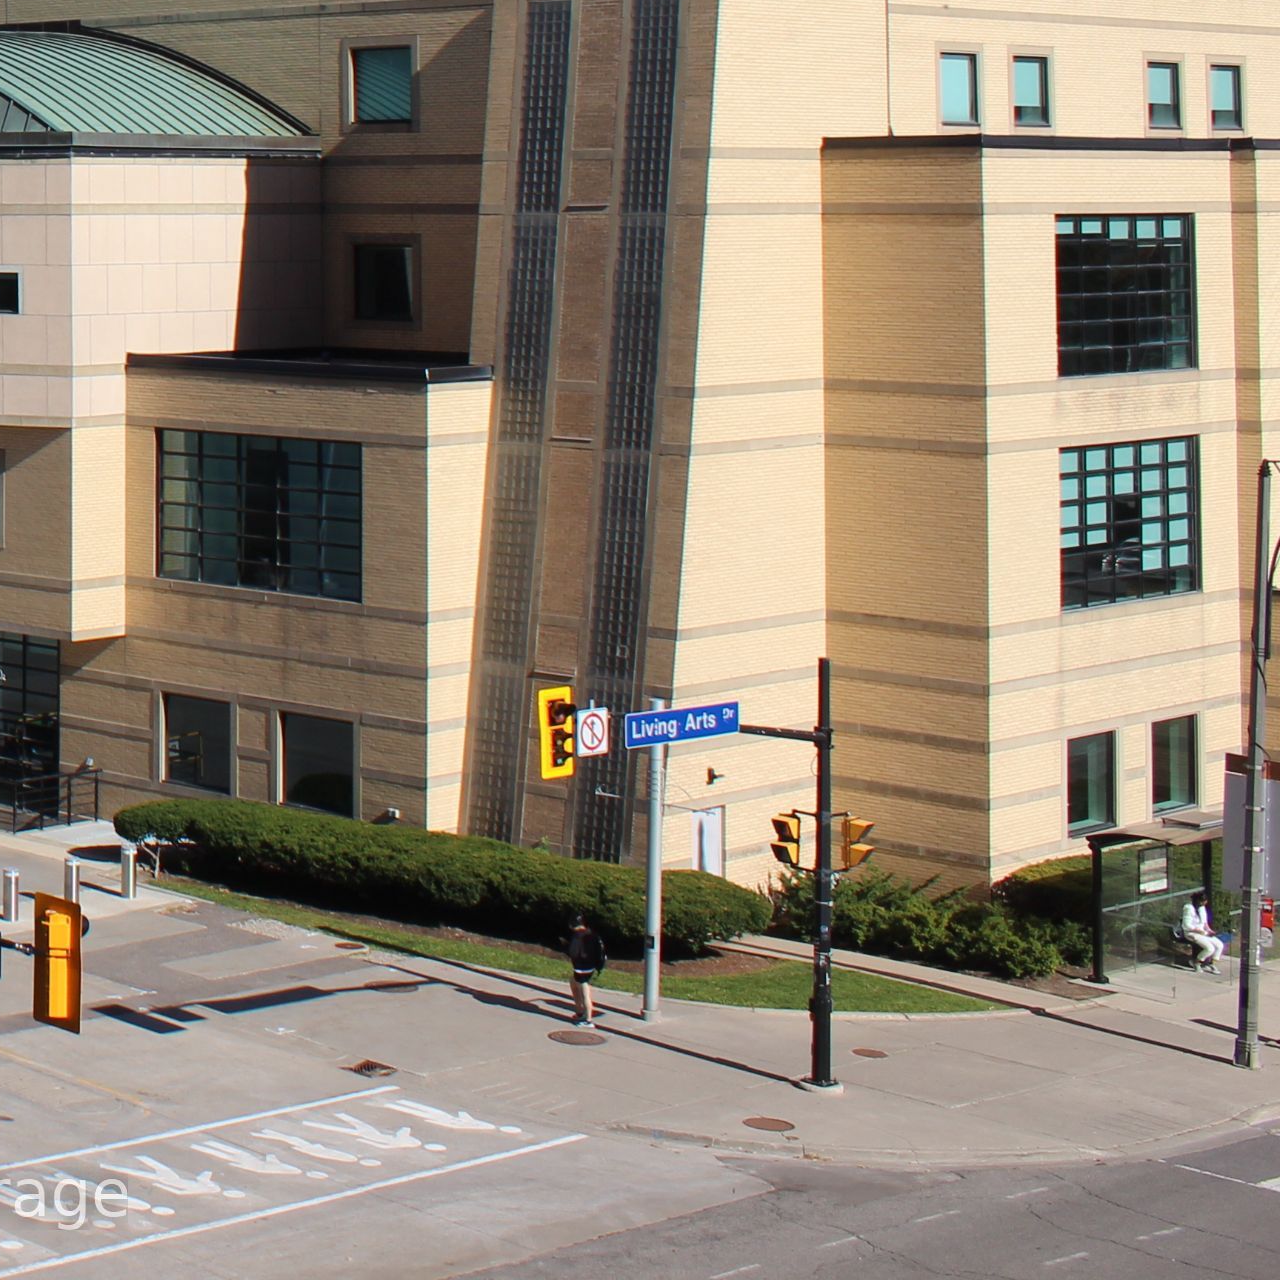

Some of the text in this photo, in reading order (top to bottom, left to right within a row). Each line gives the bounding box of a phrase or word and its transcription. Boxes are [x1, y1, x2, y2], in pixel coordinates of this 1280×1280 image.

[631, 708, 735, 739] Living Arts Dr
